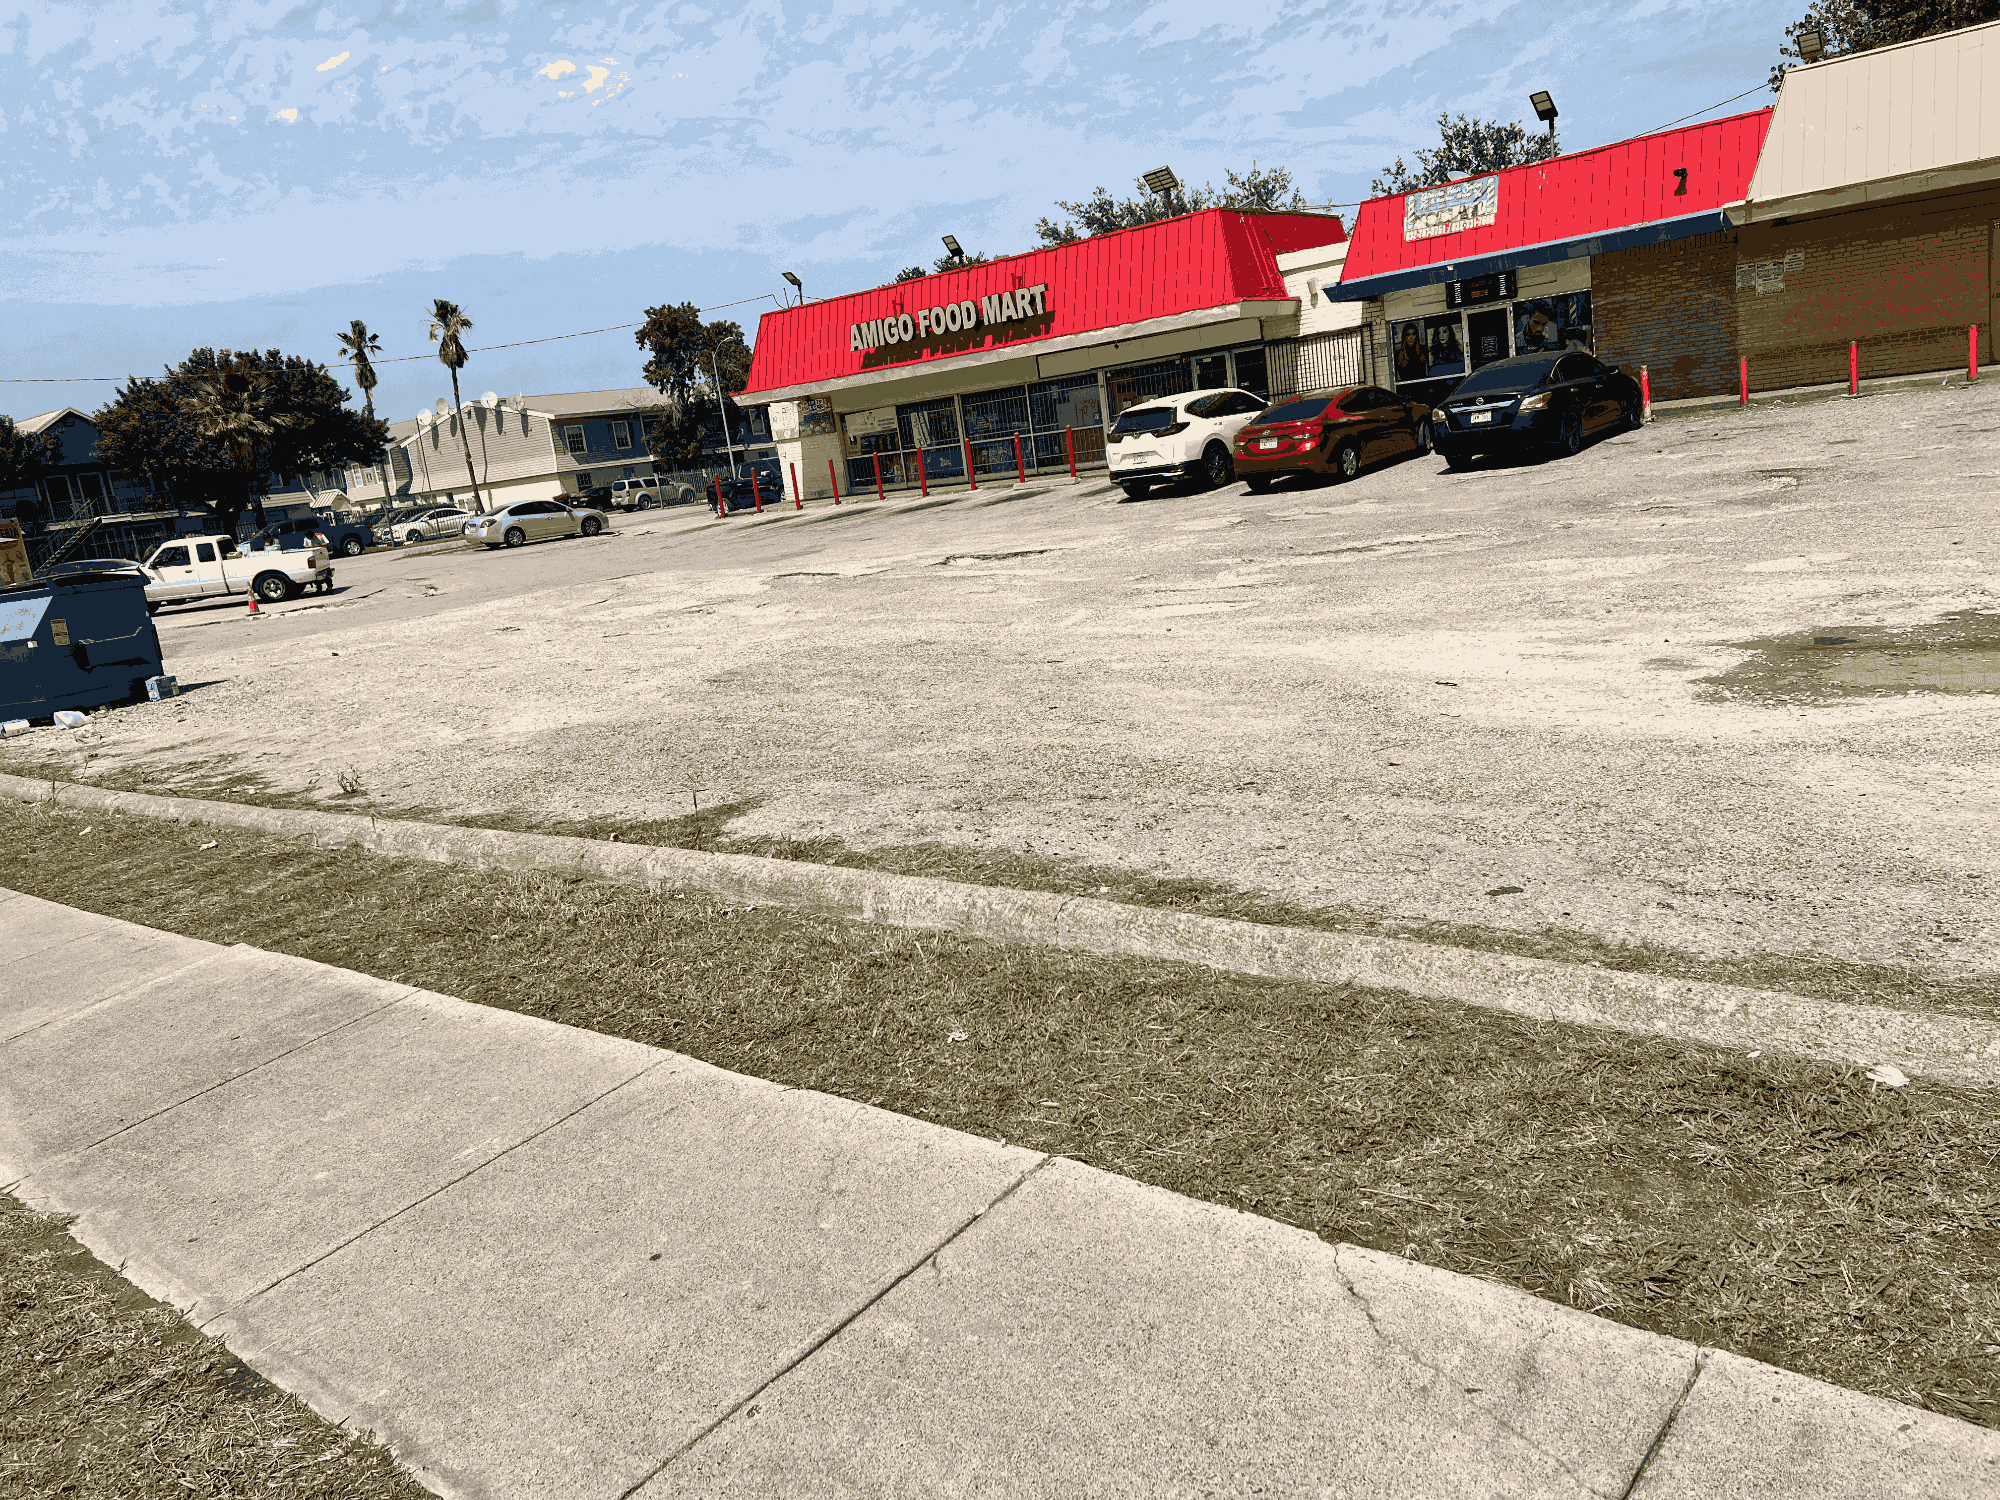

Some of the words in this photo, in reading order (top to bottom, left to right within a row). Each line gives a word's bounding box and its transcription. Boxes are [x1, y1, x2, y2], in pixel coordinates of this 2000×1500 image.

[850, 313, 915, 351] AMIGO
[917, 300, 978, 338] FOOD
[982, 284, 1048, 325] MART
